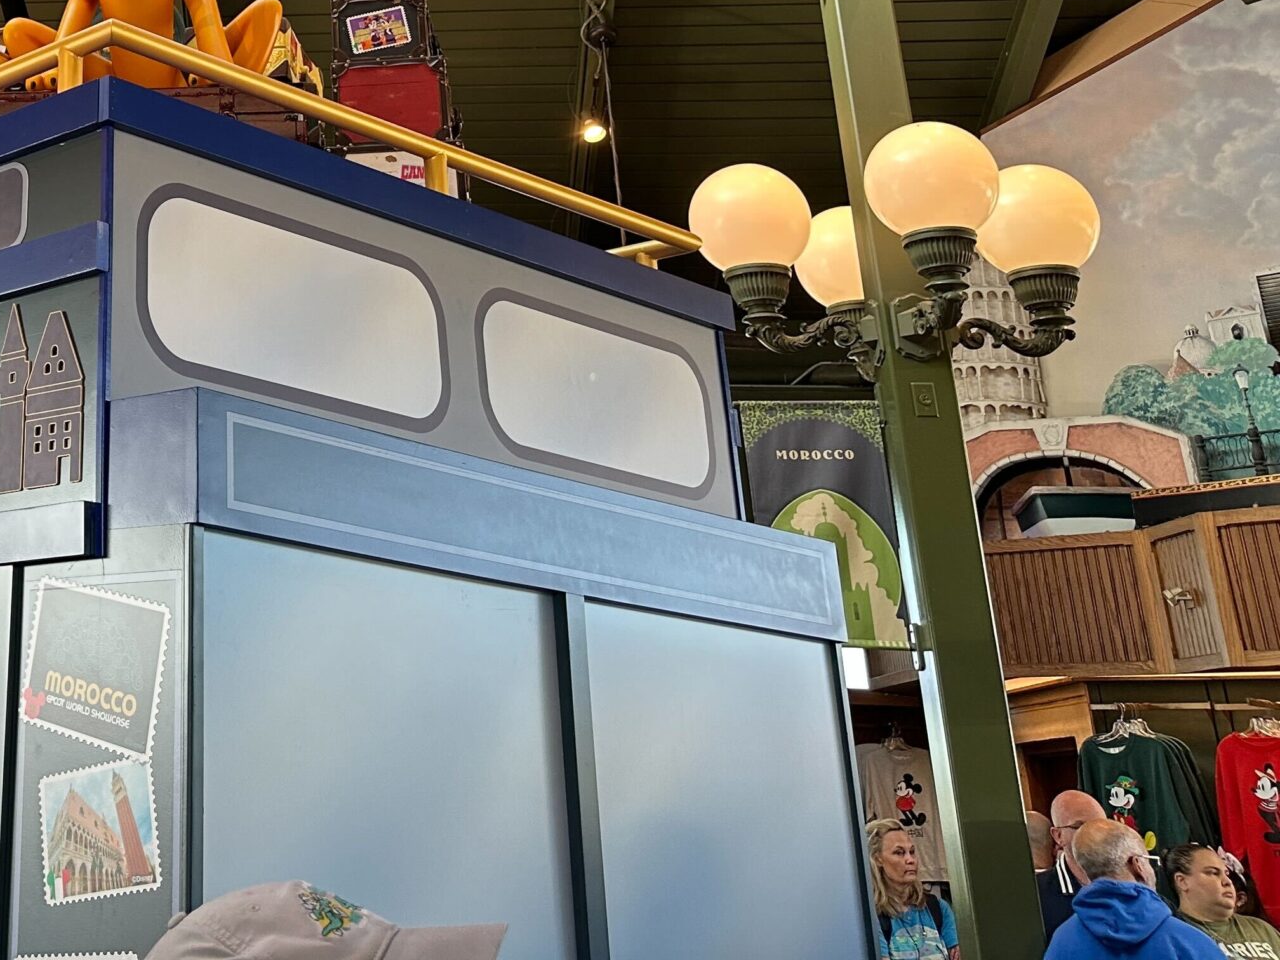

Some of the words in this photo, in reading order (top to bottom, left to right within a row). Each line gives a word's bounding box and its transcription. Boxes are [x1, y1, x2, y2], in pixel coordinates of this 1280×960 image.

[775, 449, 856, 461] MOROCCO
[45, 670, 137, 717] MOROCCO
[46, 694, 66, 708] EPCOT
[66, 700, 90, 716] WORLD
[90, 708, 131, 729] SHOWCASE
